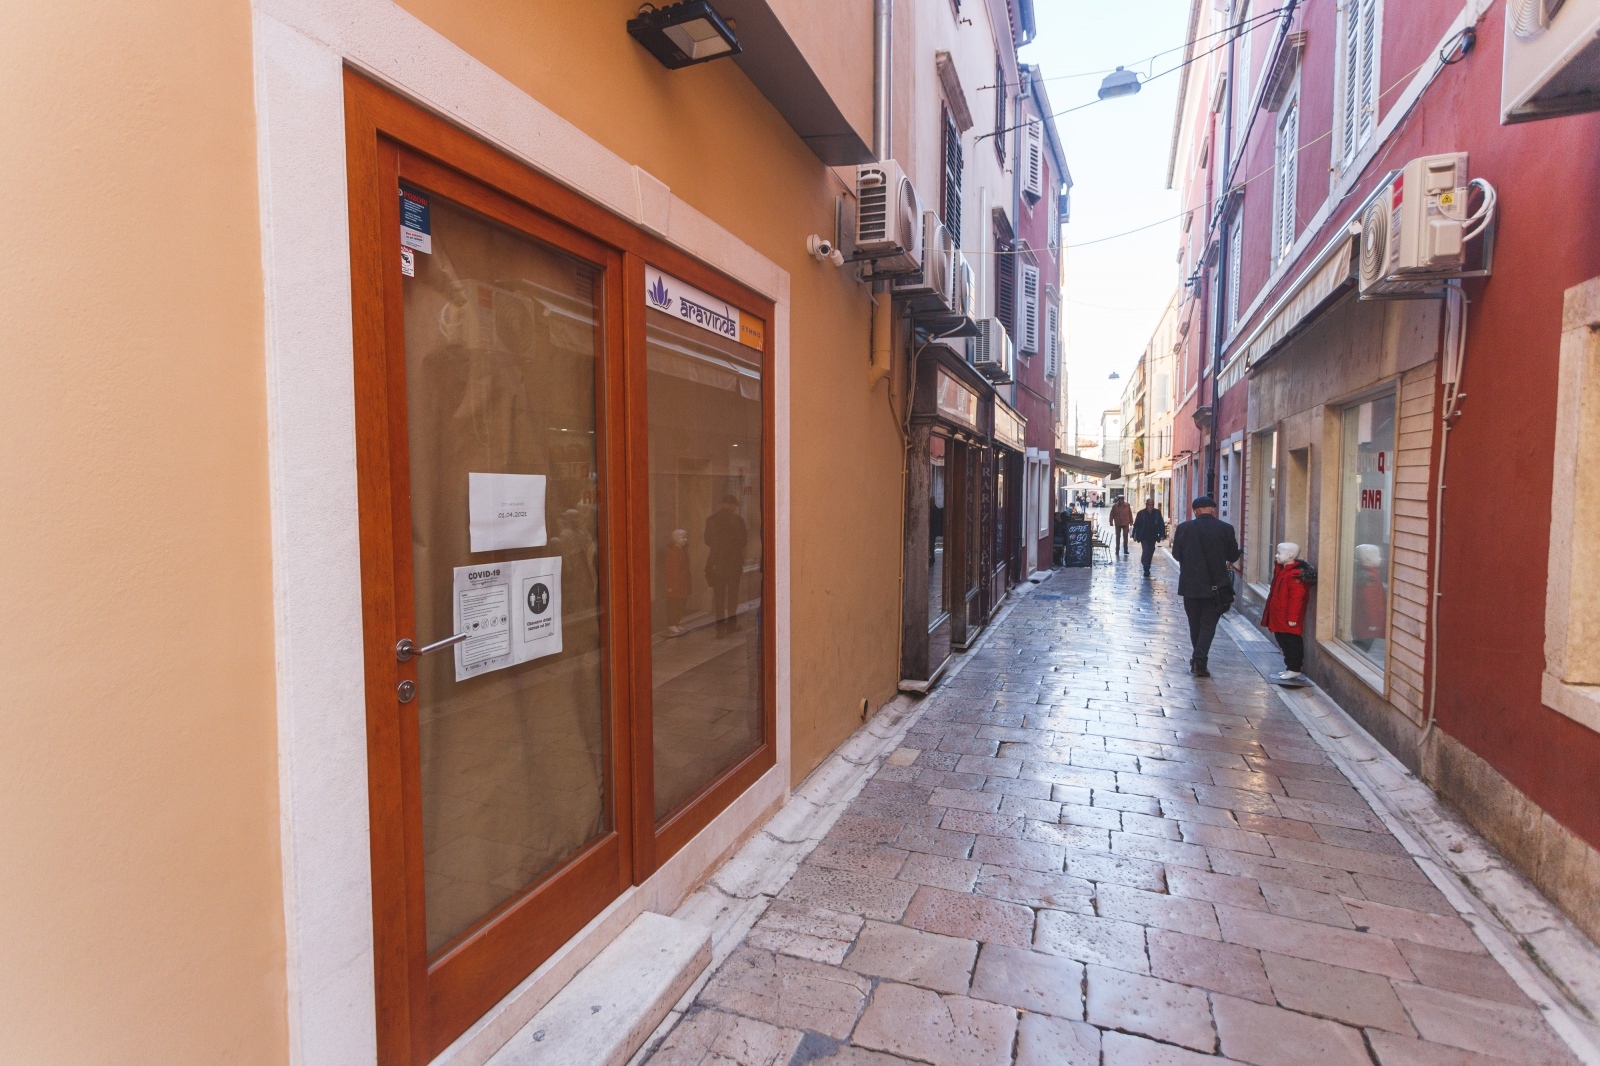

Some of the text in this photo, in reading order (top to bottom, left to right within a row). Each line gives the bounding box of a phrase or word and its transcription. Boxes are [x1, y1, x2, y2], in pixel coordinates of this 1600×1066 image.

[403, 191, 428, 206] POZOR!
[679, 296, 736, 337] aravinda
[741, 325, 761, 338] ETHNO
[1361, 489, 1382, 509] ANA
[498, 511, 527, 519] 01.04.2021
[1069, 524, 1089, 533] COFFEE
[1076, 533, 1088, 542] GO
[468, 569, 501, 580] COVID-19
